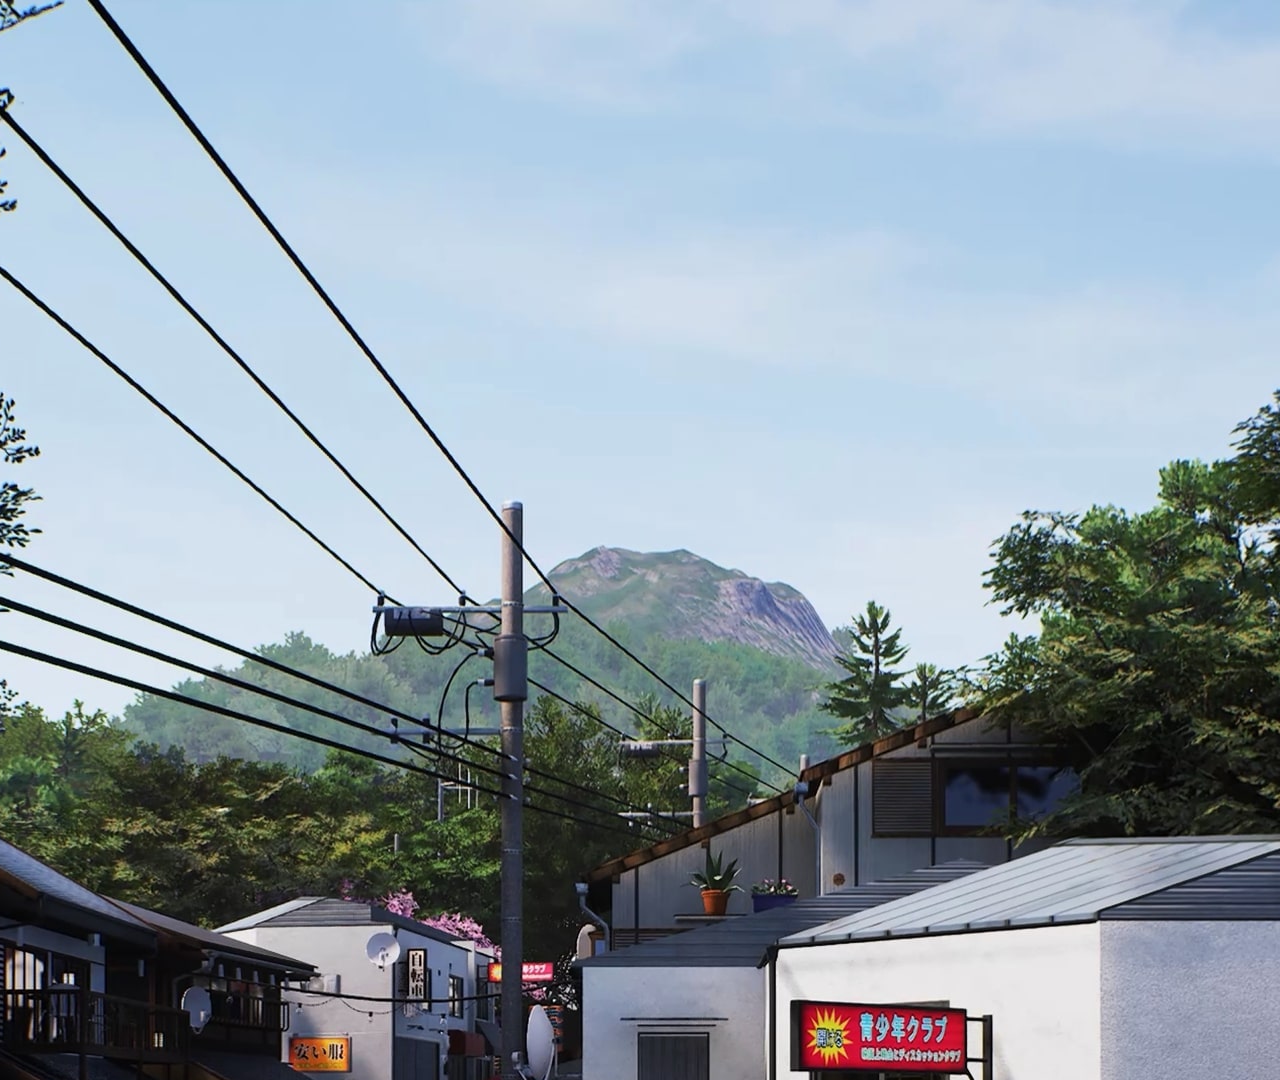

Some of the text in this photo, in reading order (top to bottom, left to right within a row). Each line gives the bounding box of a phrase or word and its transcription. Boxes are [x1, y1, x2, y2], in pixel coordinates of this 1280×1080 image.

[859, 1012, 948, 1043] 青少年クラブ
[294, 1043, 344, 1060] 安い服
